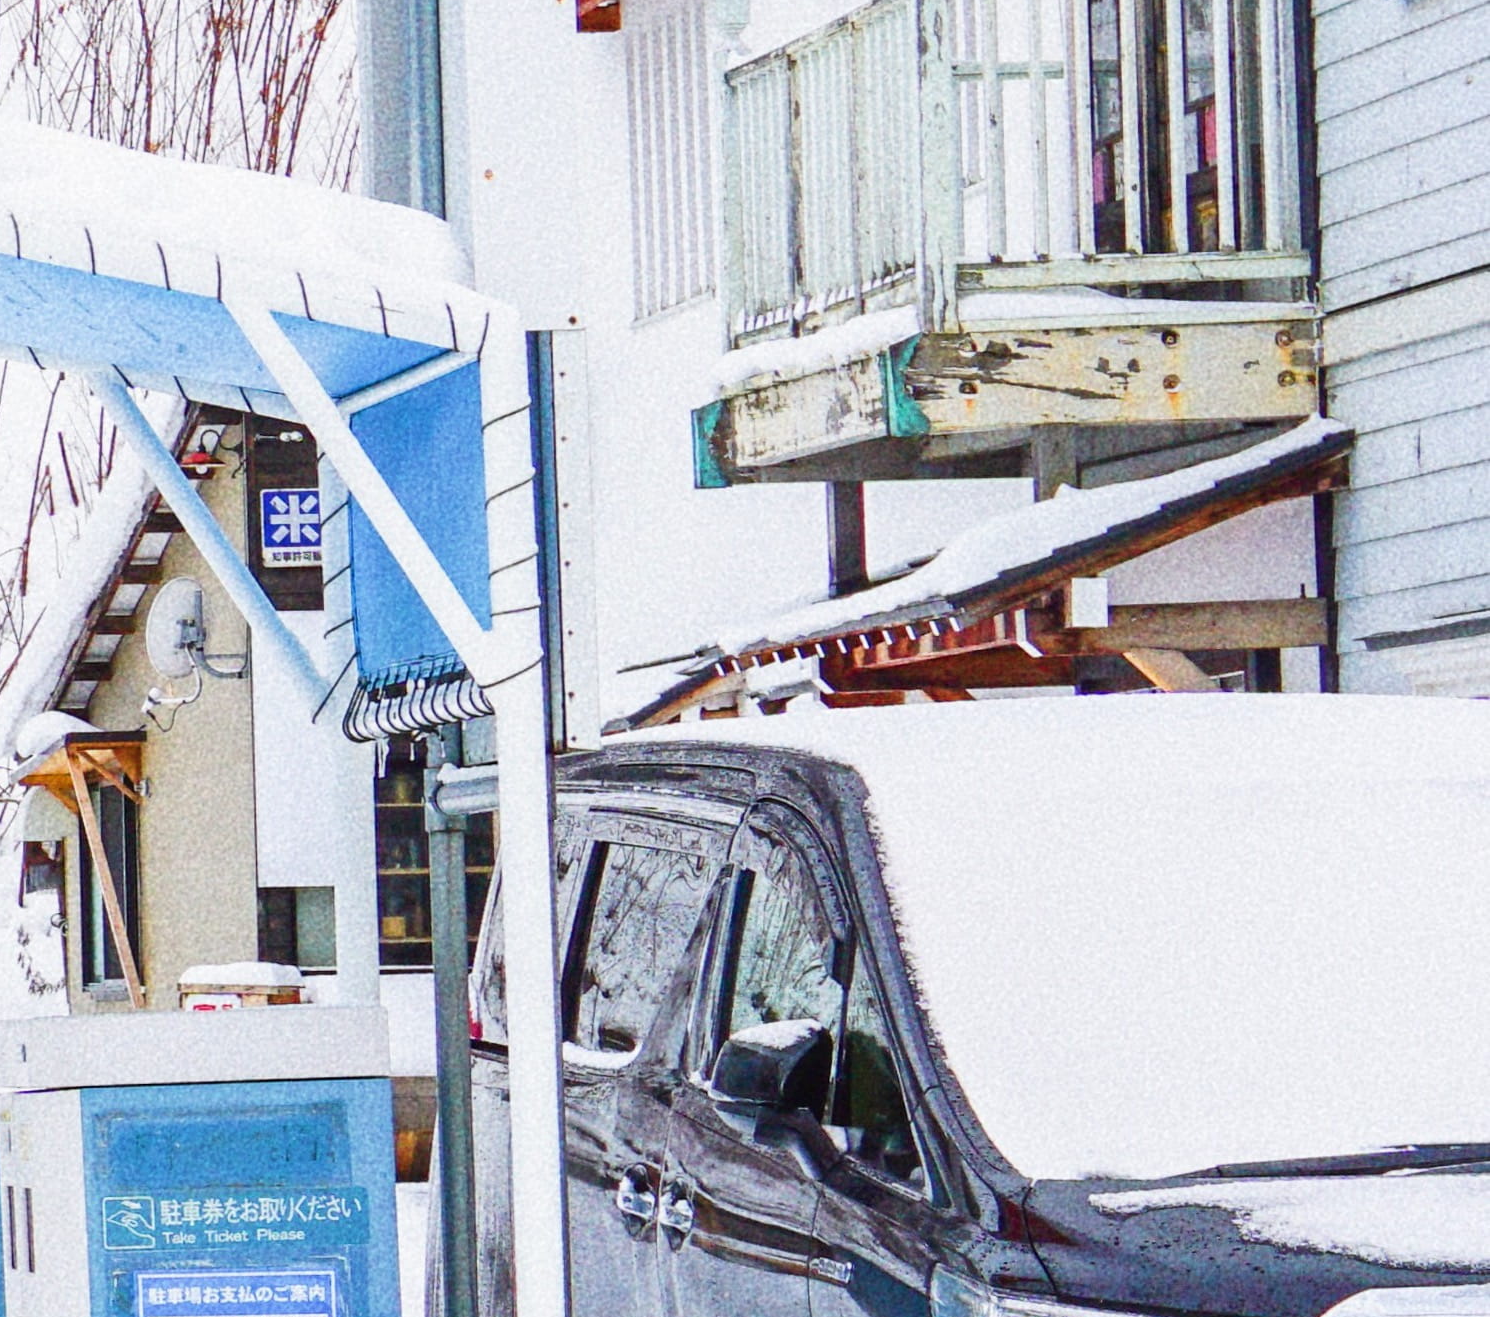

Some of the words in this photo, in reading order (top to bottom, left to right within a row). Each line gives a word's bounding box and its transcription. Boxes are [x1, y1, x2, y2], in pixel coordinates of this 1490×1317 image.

[160, 1195, 361, 1226] 駐車券をお取りください
[162, 1231, 196, 1245] Take
[204, 1230, 249, 1243] Ticket
[256, 1228, 305, 1241] Please
[148, 1284, 326, 1305] 駐車場お支払のご案内
